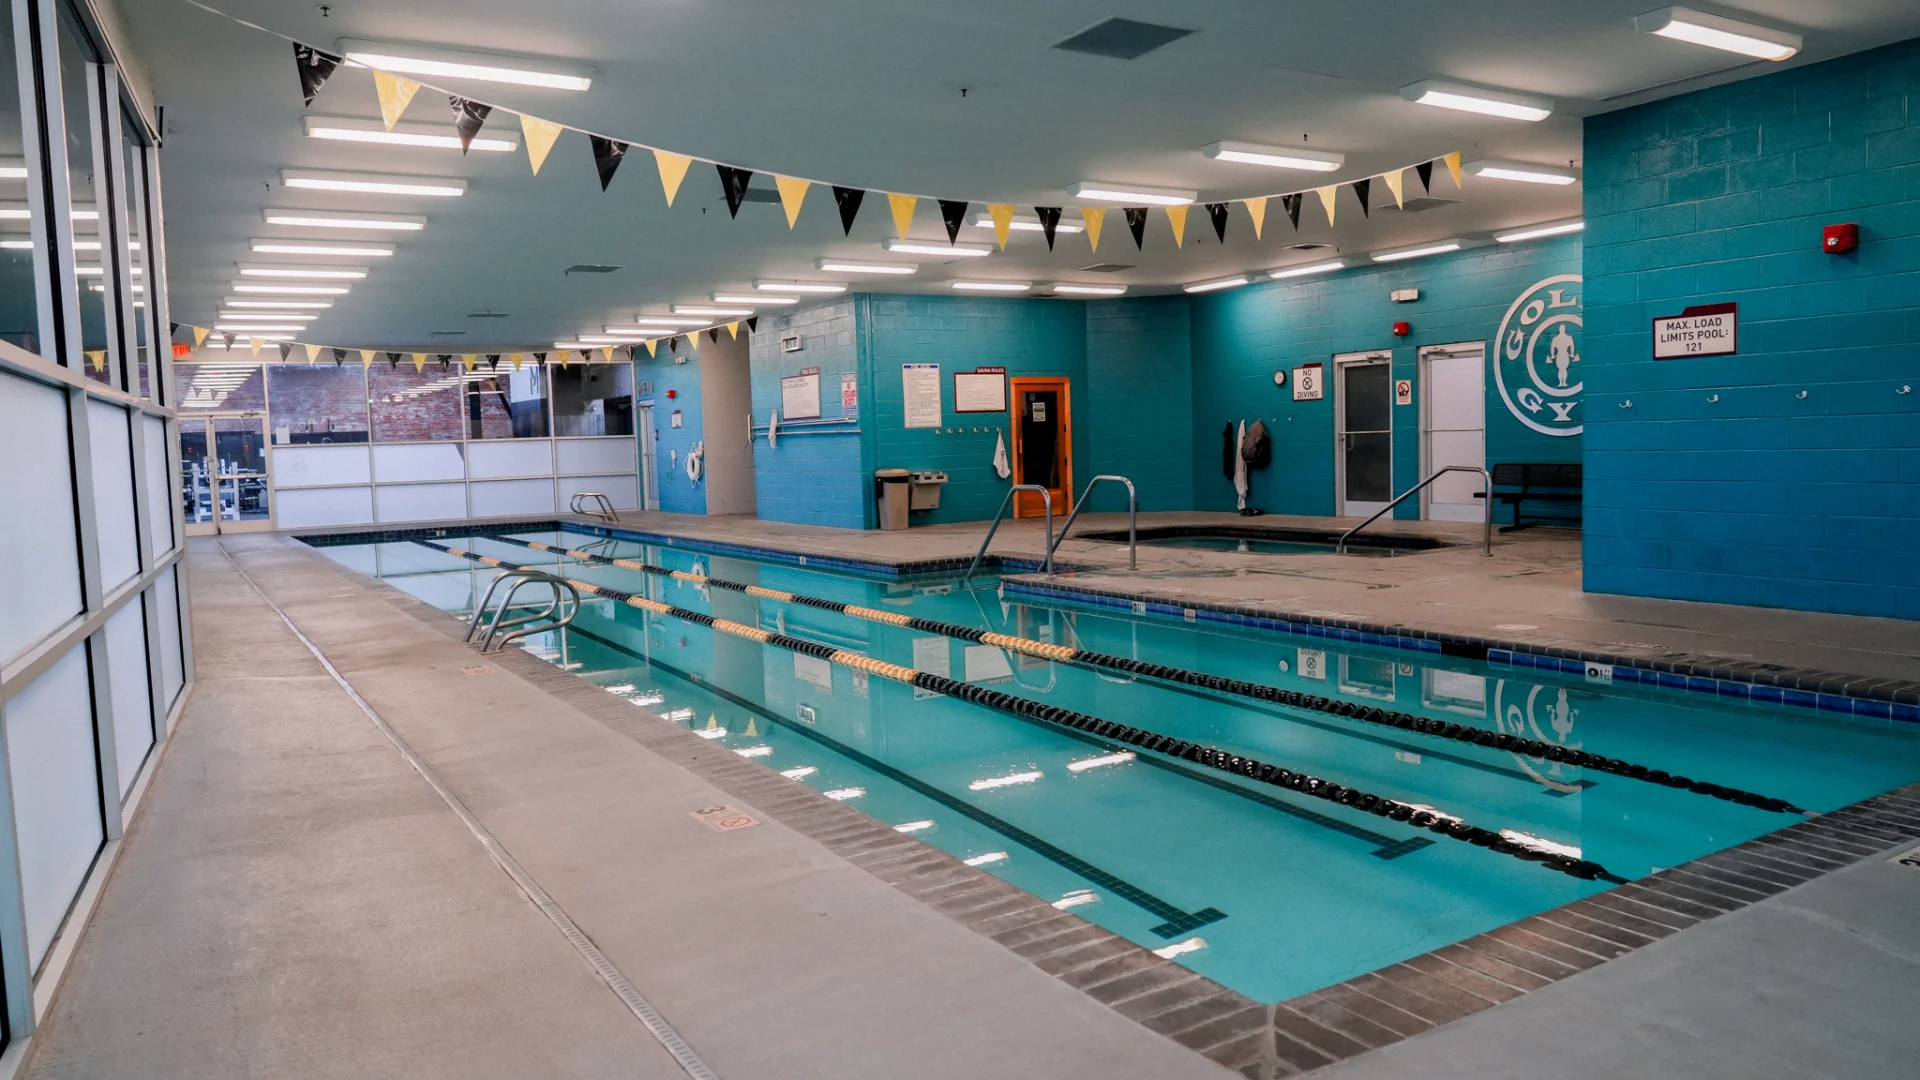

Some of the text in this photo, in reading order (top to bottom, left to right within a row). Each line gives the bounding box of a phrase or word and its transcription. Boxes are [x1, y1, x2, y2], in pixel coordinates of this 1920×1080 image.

[1506, 289, 1583, 360] GOL
[1666, 317, 1722, 331] MAX. LOAD
[1660, 329, 1729, 343] LIMITS POOL:
[173, 345, 189, 356] EXIT
[1685, 342, 1702, 352] 121
[1517, 387, 1583, 422] GY
